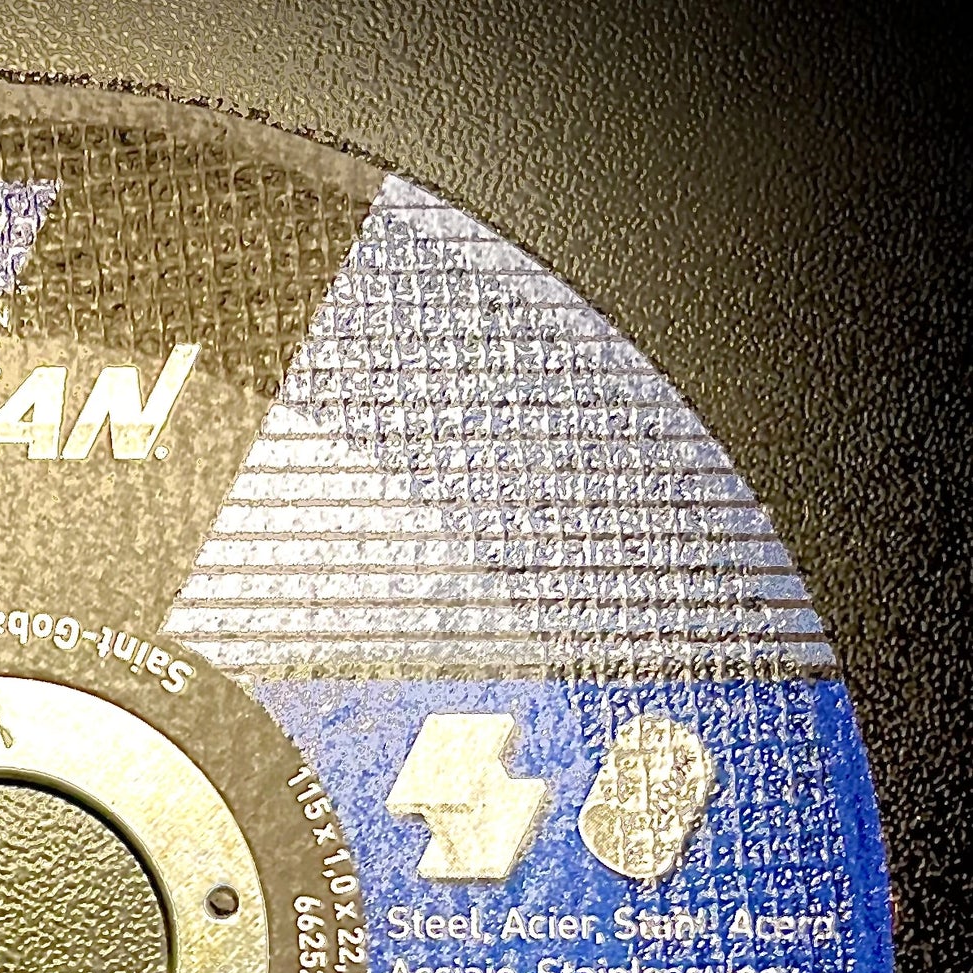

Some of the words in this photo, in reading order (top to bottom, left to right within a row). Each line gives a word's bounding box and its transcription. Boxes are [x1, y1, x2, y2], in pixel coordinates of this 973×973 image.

[287, 766, 331, 821] 115
[321, 848, 358, 895] 1,0
[386, 905, 492, 946] Steel,
[500, 905, 604, 944] Acier,
